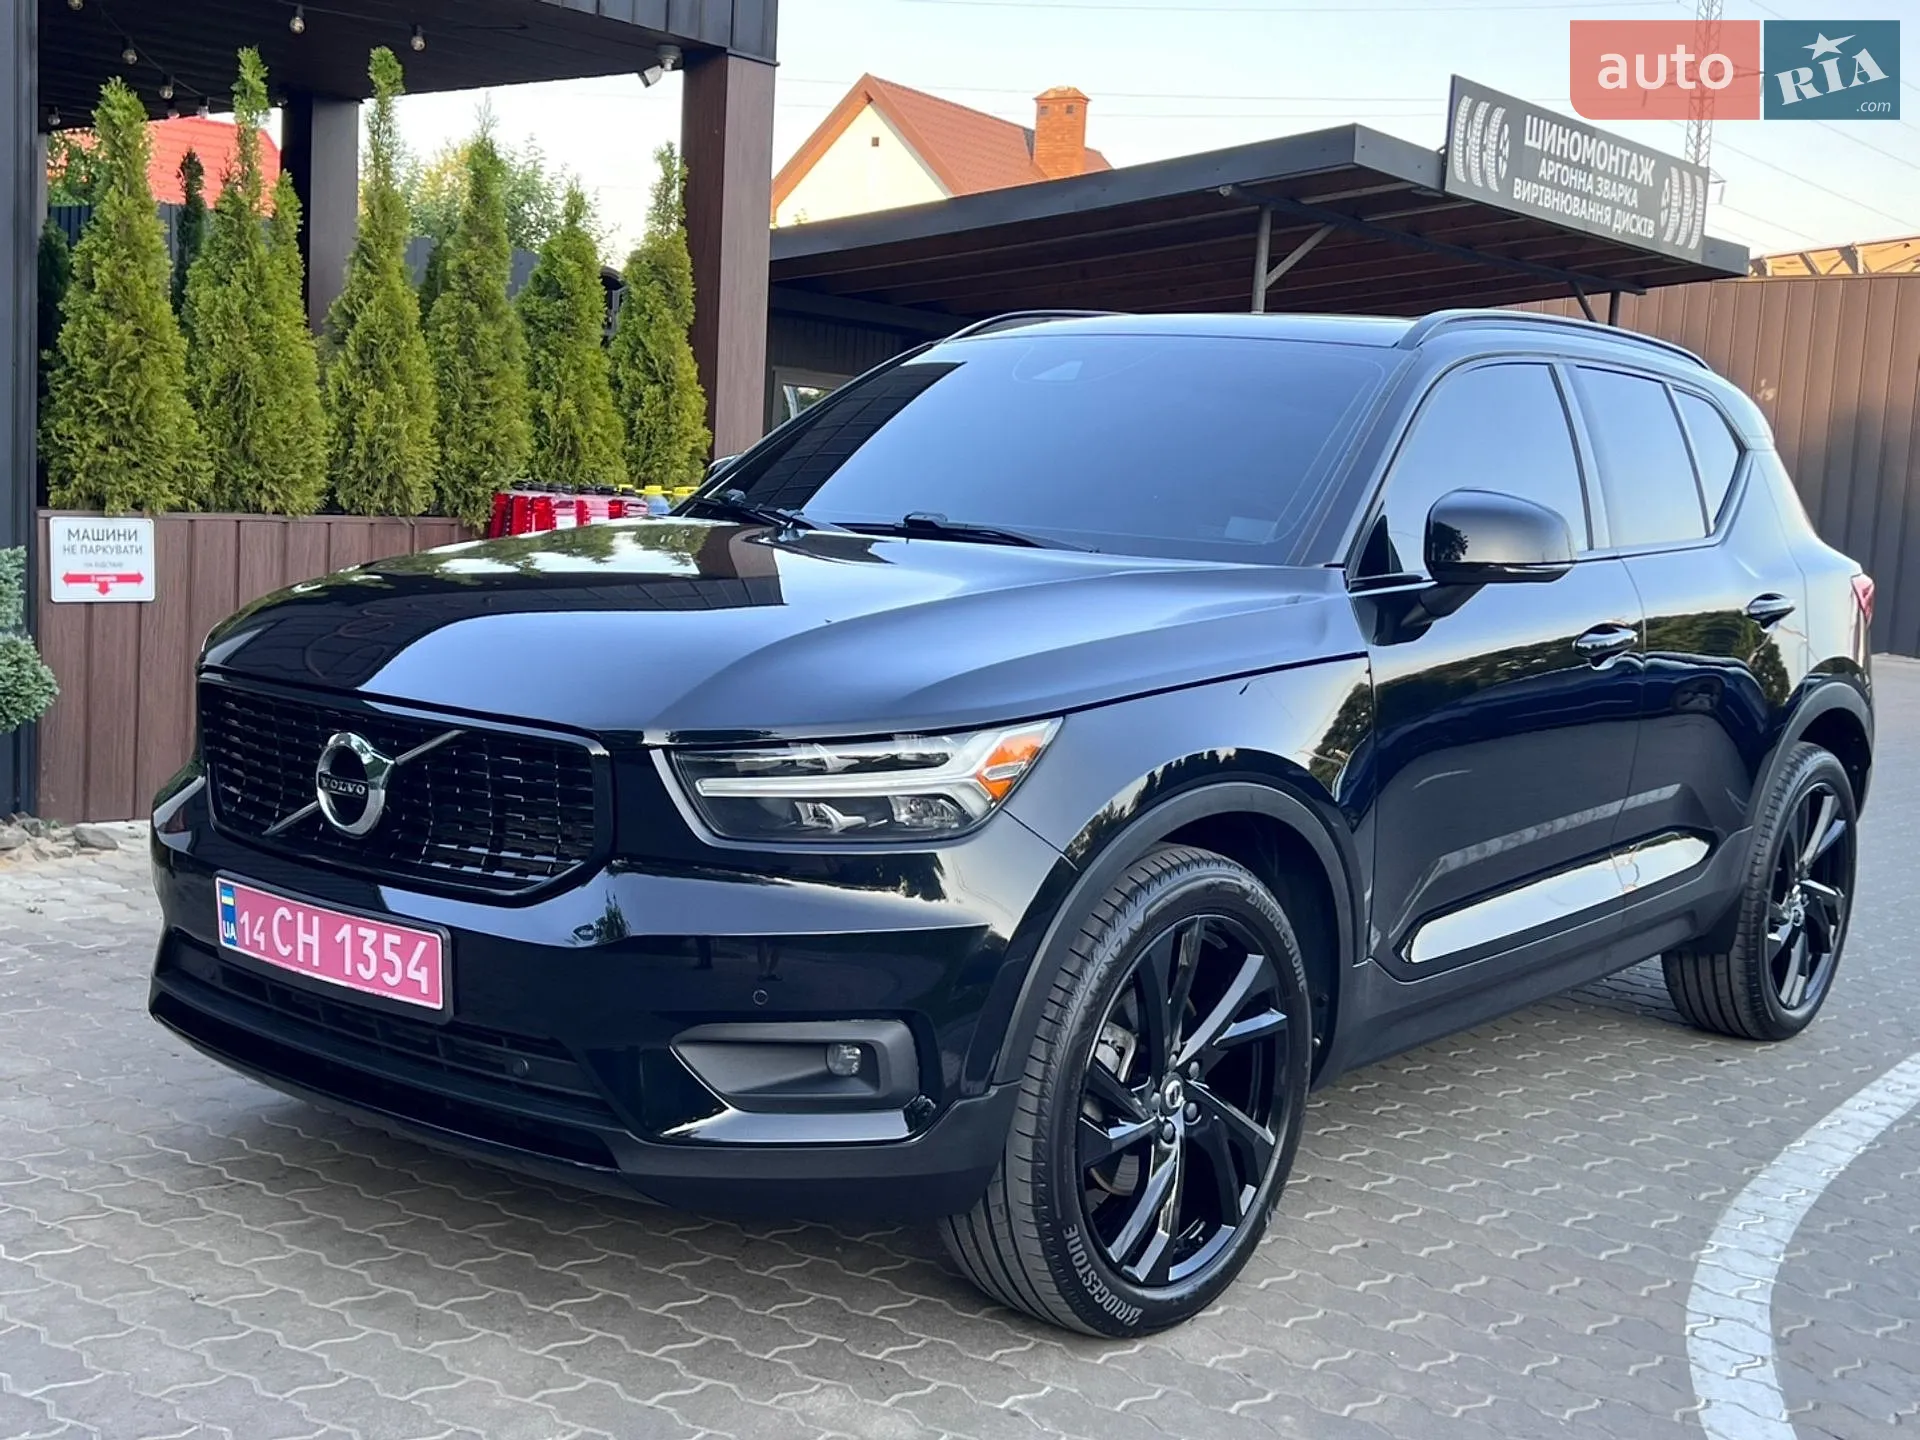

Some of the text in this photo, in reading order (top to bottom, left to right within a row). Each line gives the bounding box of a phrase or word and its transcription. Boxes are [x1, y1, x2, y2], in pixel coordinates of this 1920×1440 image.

[1523, 113, 1656, 188] ШИНОМОНТАЖ
[1513, 177, 1656, 239] ВИРІВНЮВАННЯ ДИСКІВ
[1538, 157, 1639, 209] АРГОННА ЗВАРКА
[63, 544, 143, 555] НЕ ПАРКУВАТИ
[67, 528, 138, 541] МАШИНИ
[320, 776, 366, 795] VOLVO
[222, 920, 237, 940] UA
[334, 923, 429, 995] 1354
[1062, 1223, 1144, 1327] BRIDGESTONE
